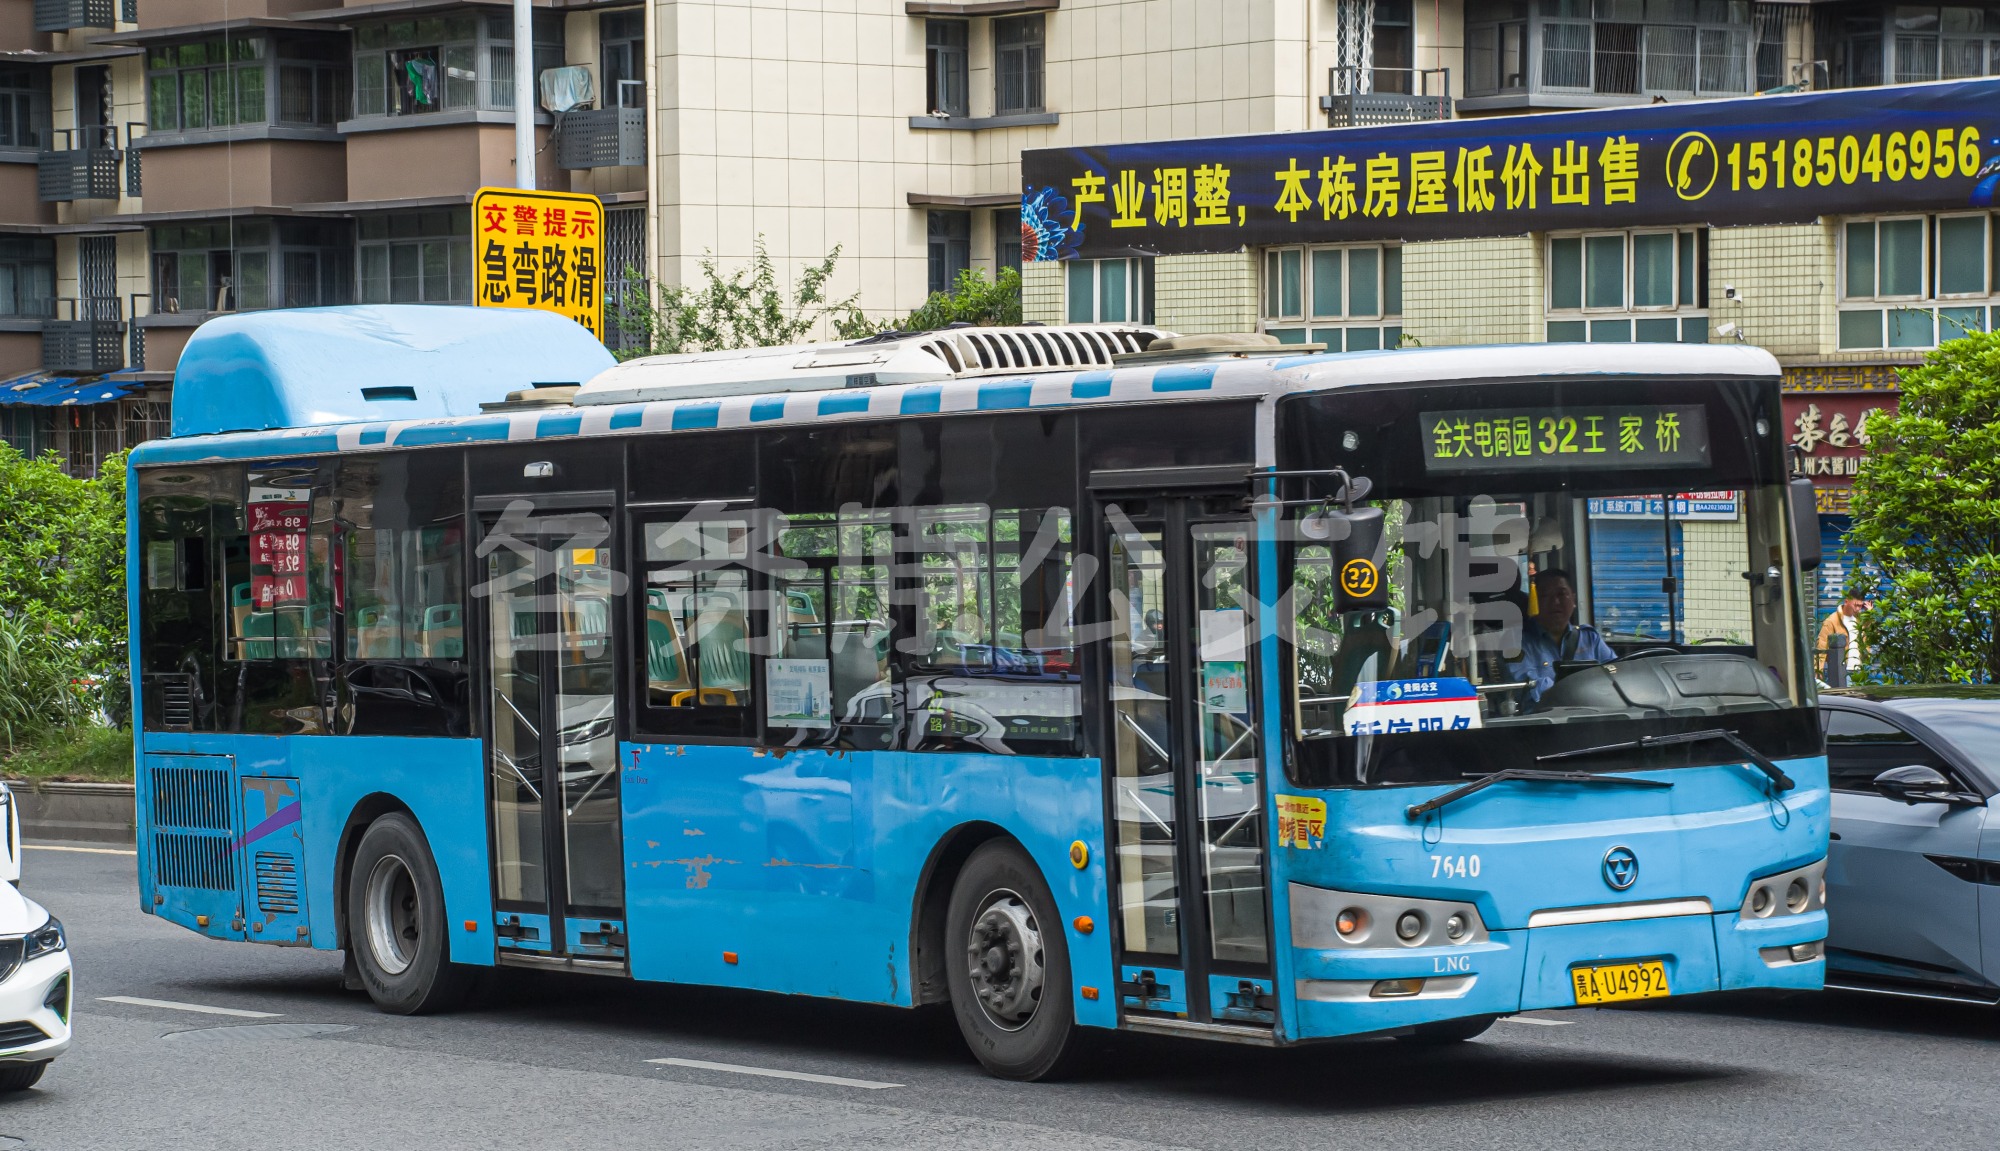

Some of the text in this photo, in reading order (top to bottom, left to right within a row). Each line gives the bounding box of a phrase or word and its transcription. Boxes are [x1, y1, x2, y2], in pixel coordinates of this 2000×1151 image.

[1727, 126, 1981, 192] 15185046956
[483, 204, 595, 239] 交警提示
[483, 239, 596, 308] 急弯路滑
[1538, 416, 1578, 454] 32
[1606, 501, 1643, 512] 系统门窗
[1348, 567, 1372, 588] 32
[1430, 855, 1481, 879] 7640
[1433, 956, 1471, 973] LNG
